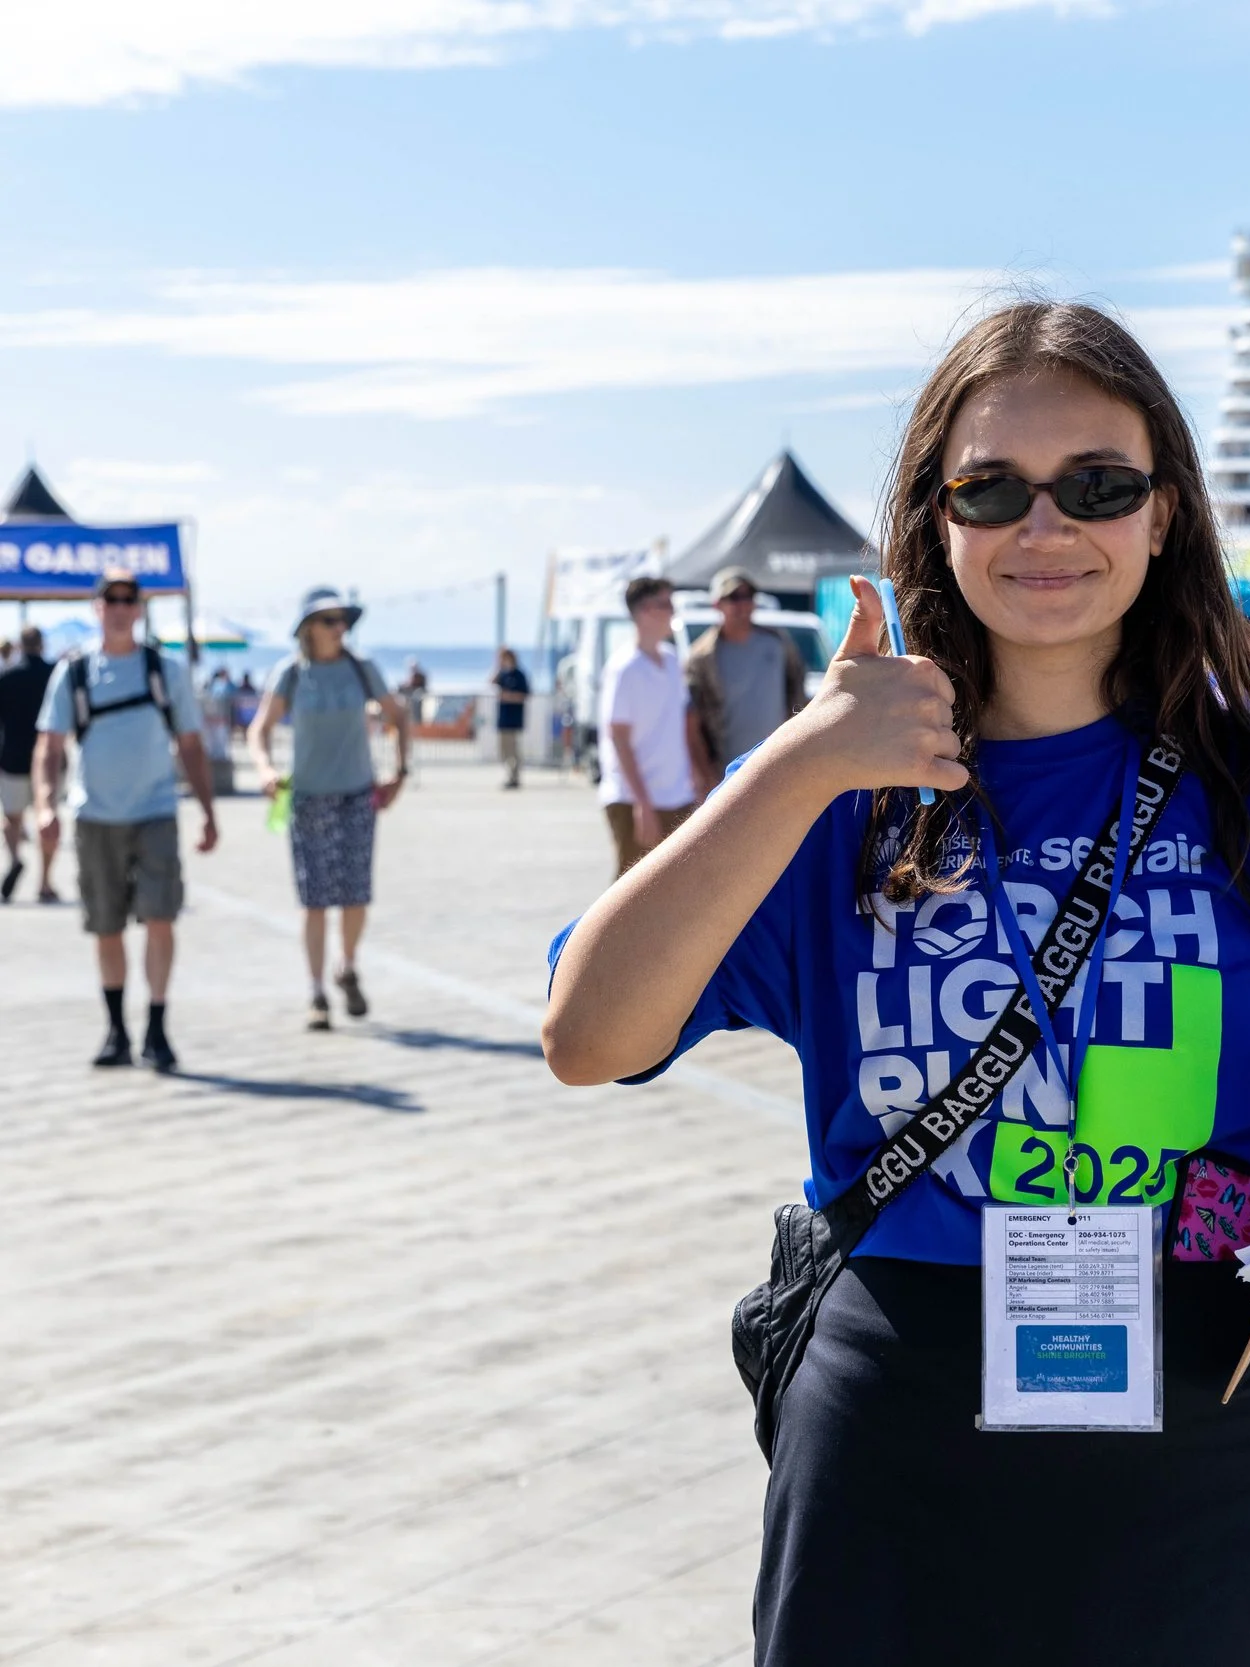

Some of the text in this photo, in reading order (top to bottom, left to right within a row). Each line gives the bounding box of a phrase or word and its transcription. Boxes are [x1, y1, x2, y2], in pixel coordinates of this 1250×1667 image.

[24, 541, 170, 575] GARDEN
[1040, 833, 1207, 875] seair
[856, 881, 1219, 968] TORCH
[920, 1029, 1025, 1142] BAGGU
[1014, 897, 1101, 1025] BAGGU
[1014, 1136, 1189, 1203] 2025
[1008, 1240, 1046, 1248] Operations
[1029, 1232, 1066, 1240] Emergency
[1040, 1343, 1103, 1351] COMMUNITIES
[1052, 1335, 1091, 1343] HEALTHY
[1037, 1351, 1107, 1359] SHINE BRIGHTER
